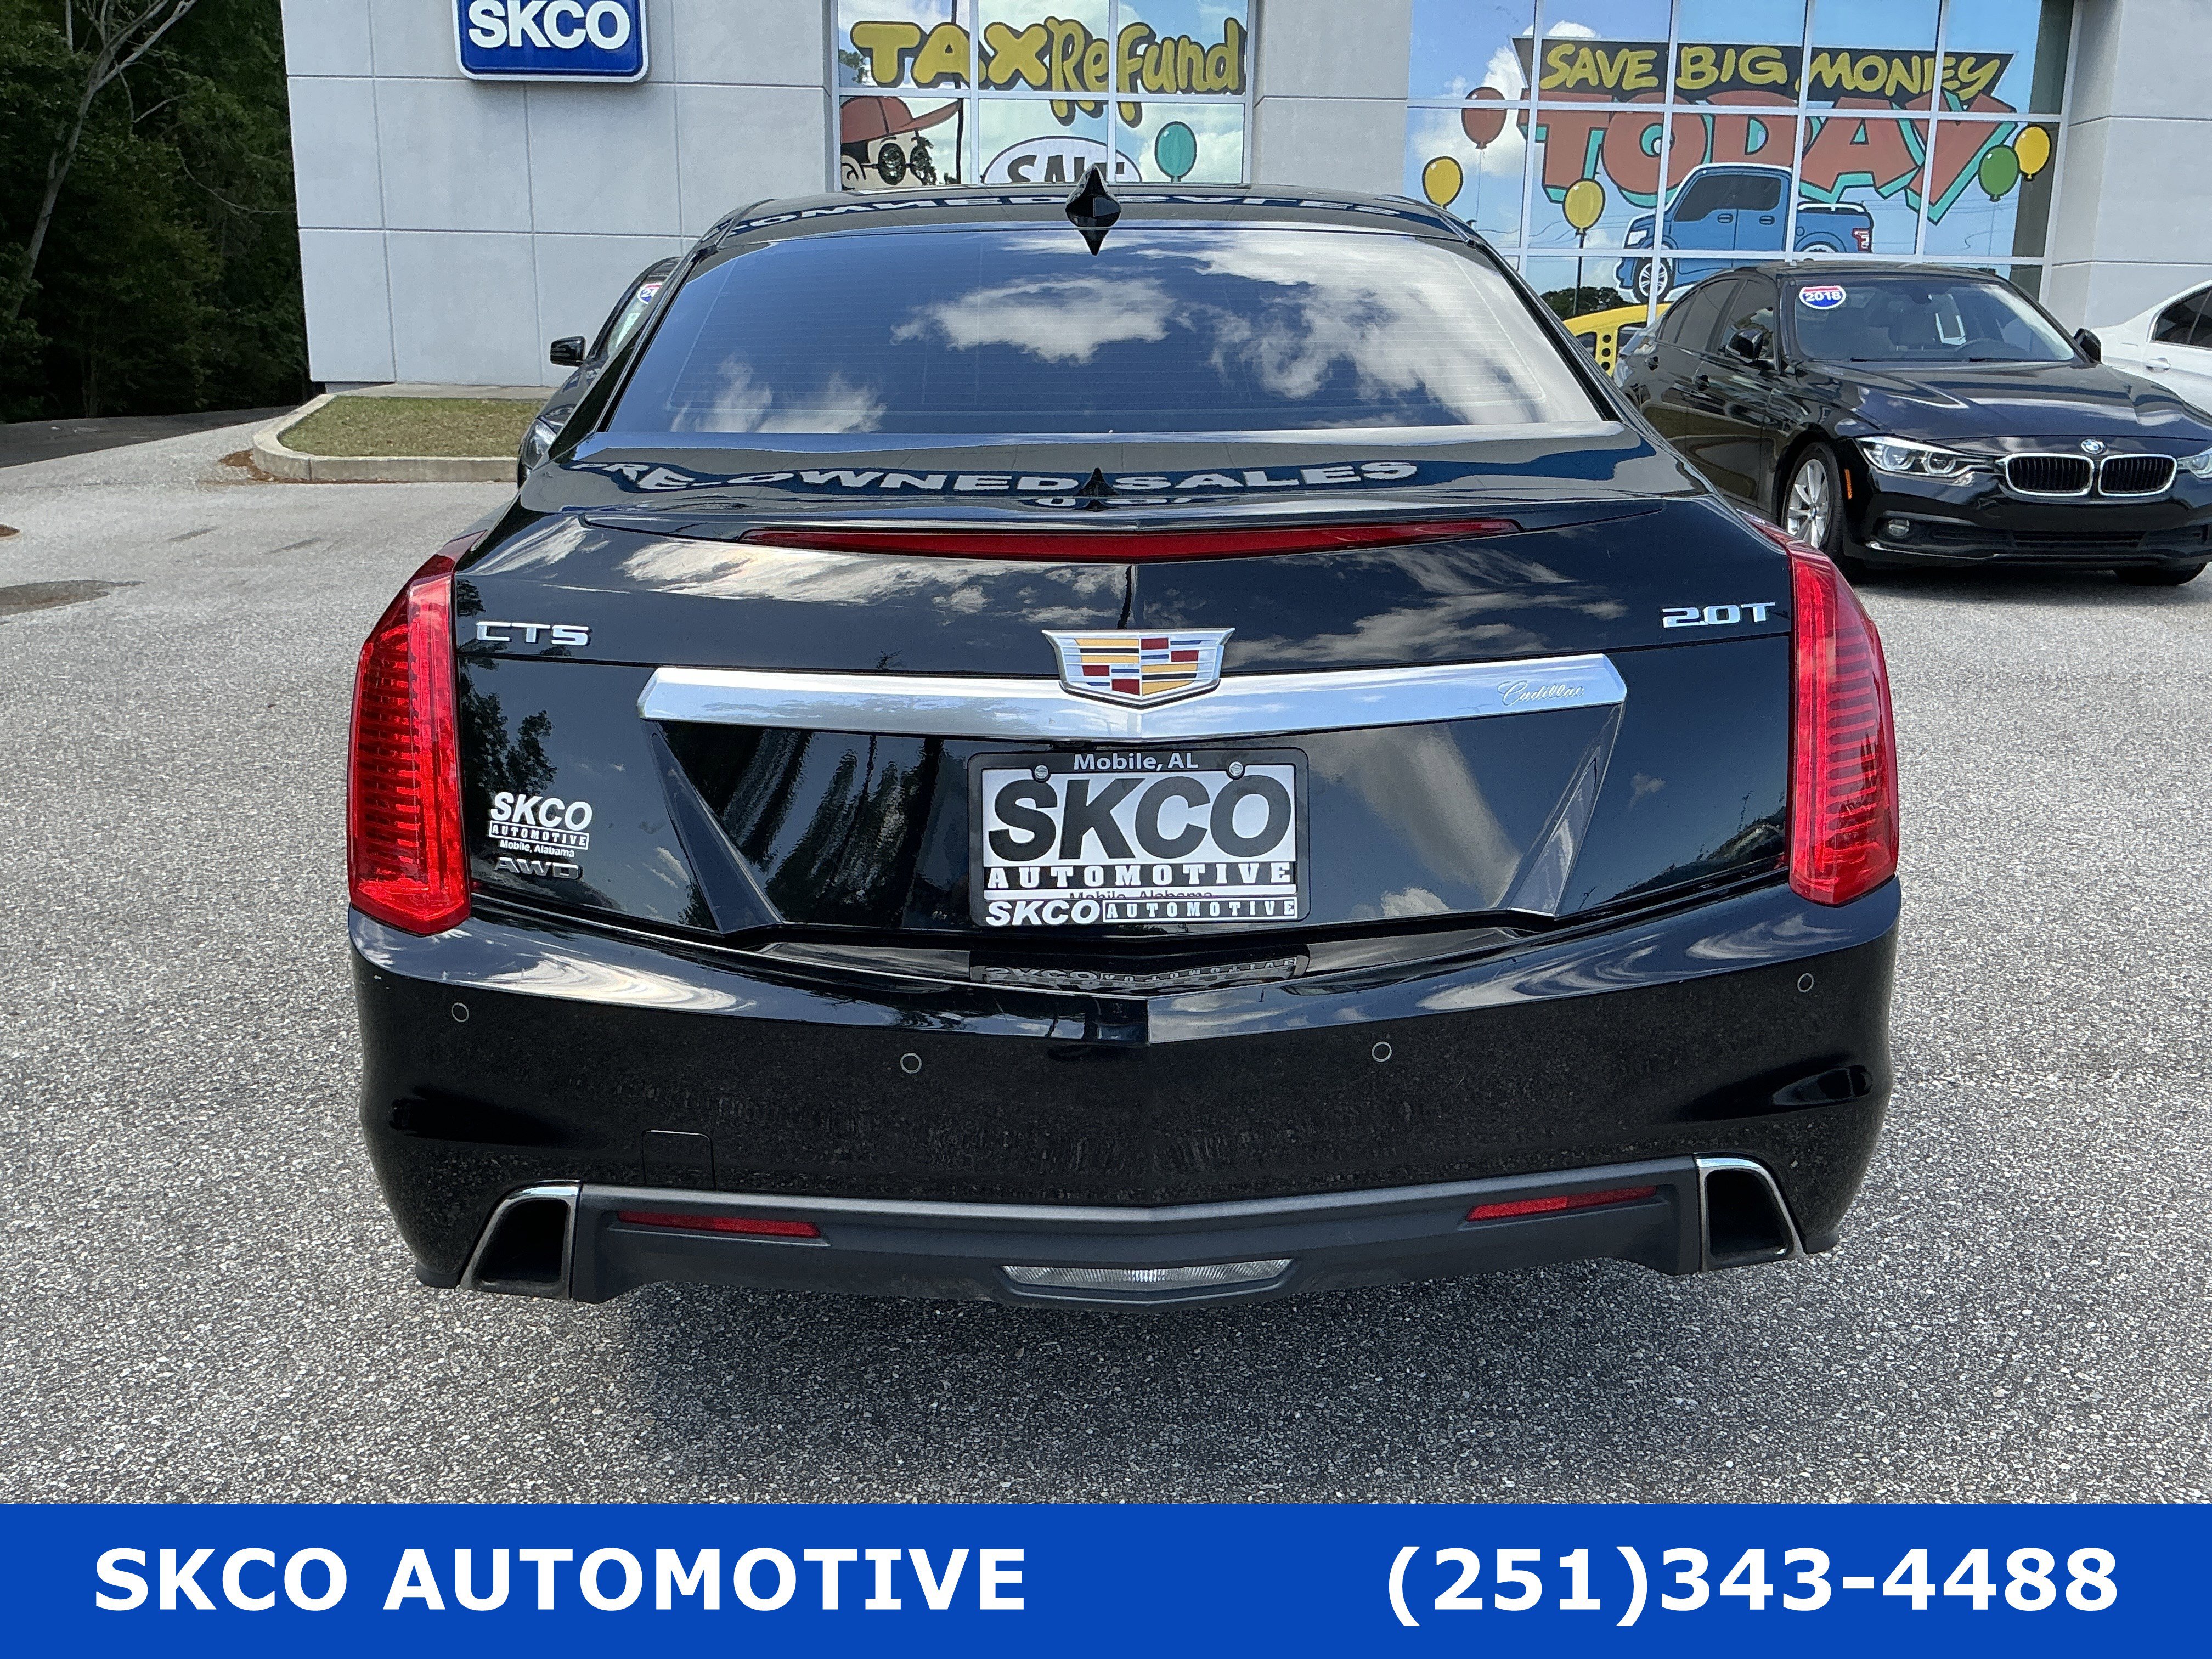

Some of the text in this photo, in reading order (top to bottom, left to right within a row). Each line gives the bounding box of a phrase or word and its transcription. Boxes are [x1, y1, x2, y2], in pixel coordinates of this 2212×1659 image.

[468, 0, 630, 50] SKCO
[851, 16, 1245, 126] TAX Refund
[1539, 43, 2001, 97] SAVE BIG MONEY
[1519, 89, 2017, 224] TODAY
[1804, 291, 1842, 302] 2018
[1112, 461, 1418, 490] SALES
[476, 621, 589, 646] CTS
[1497, 680, 1584, 706] Cadillac
[1074, 752, 1199, 771] Mobile, AL
[490, 792, 592, 831] SKCO
[988, 775, 1291, 862] SKCO
[492, 824, 586, 846] AUTOMOTIVE
[500, 839, 575, 857] Mobile, Alabama
[494, 856, 583, 879] AWD
[987, 862, 1291, 888] AUTOMOTIVE
[985, 900, 1296, 926] SKCO AUTOMOTIVE
